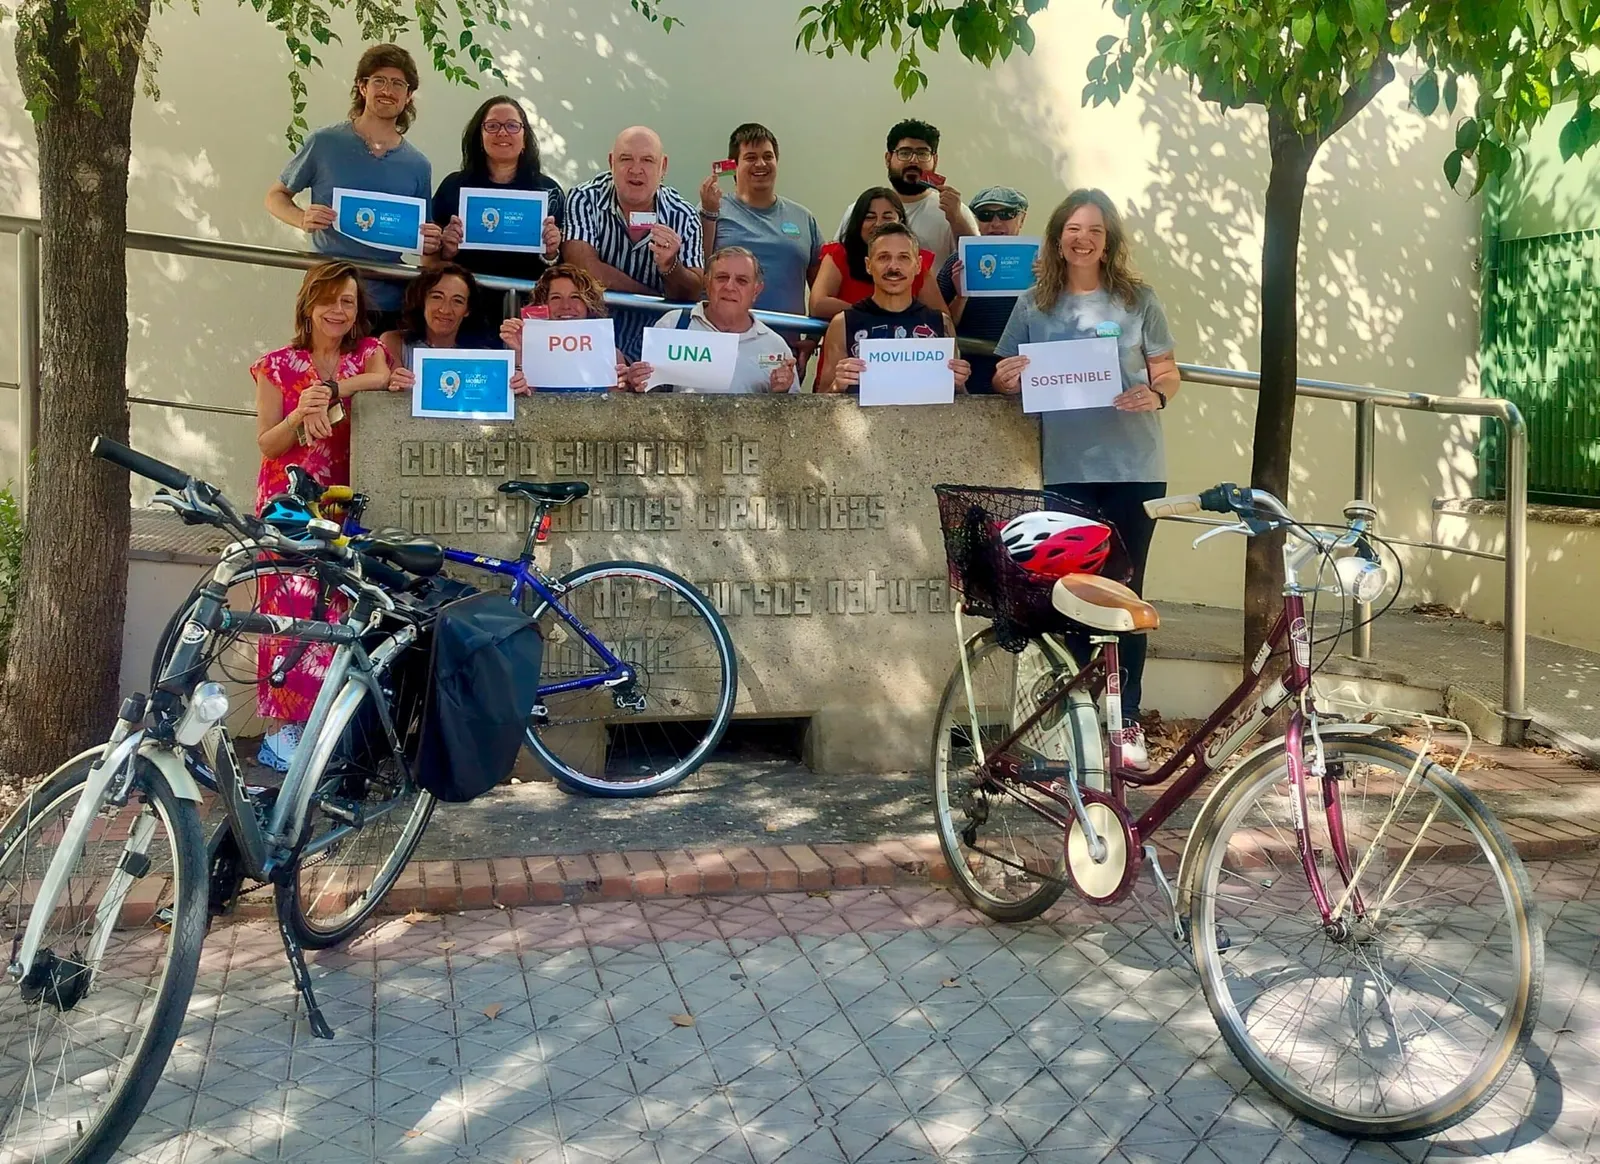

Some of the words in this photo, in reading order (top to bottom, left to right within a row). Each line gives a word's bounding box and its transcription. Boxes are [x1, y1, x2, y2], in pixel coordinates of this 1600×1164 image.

[548, 335, 593, 352] POR
[668, 344, 712, 363] UNA
[869, 350, 945, 363] MOVILIDAD
[1030, 370, 1112, 388] SOSTENIBLE
[721, 433, 760, 476] de
[401, 488, 682, 535] investiaciones
